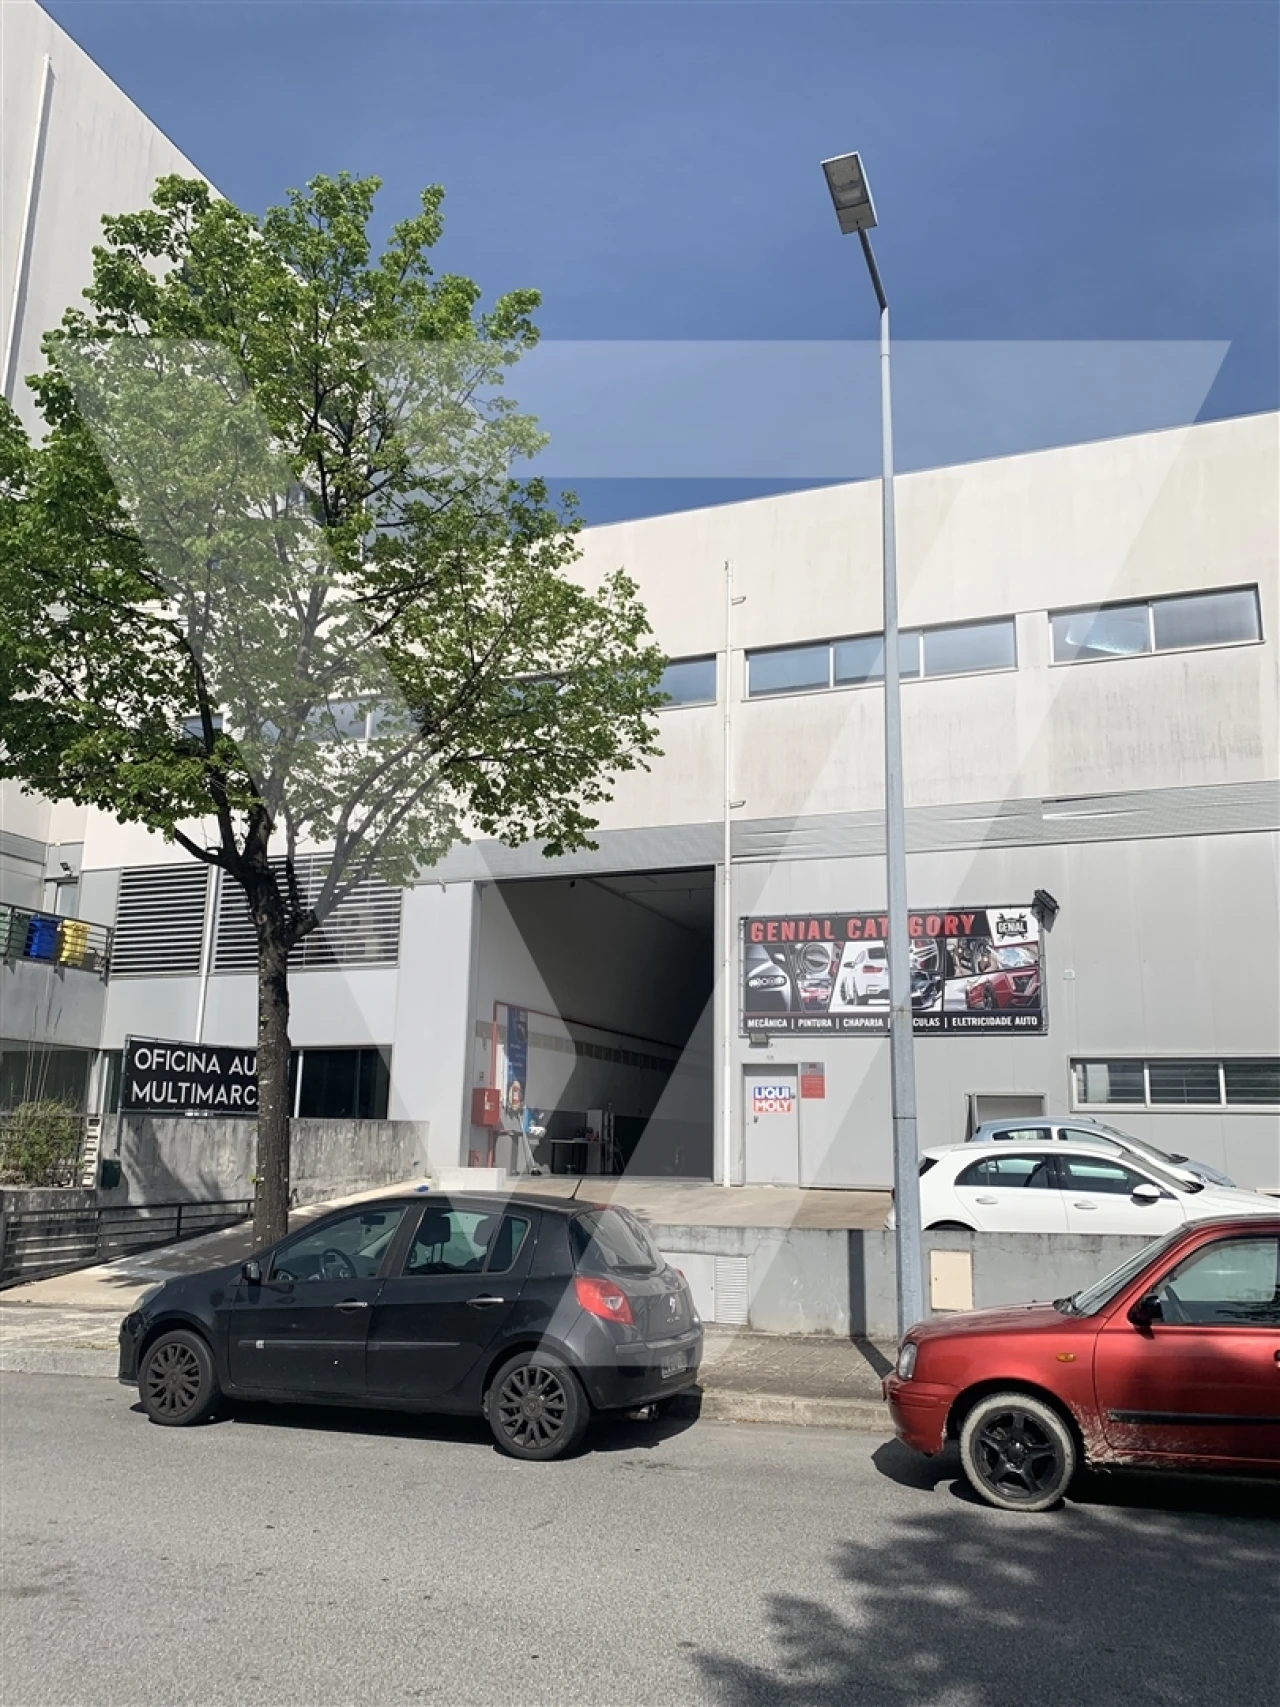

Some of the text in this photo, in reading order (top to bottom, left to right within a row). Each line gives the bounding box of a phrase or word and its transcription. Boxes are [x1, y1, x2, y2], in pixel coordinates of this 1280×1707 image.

[751, 915, 974, 941] GENIAL CATGORY
[998, 922, 1026, 932] GENIAL
[748, 1016, 1038, 1028] MECÂNICA PINTURA CHAPARIA CULAS ELETRICIDADE AUTO
[134, 1048, 258, 1076] OFICINA AU
[131, 1080, 259, 1106] MULTIMARC
[755, 1100, 790, 1112] MOLY
